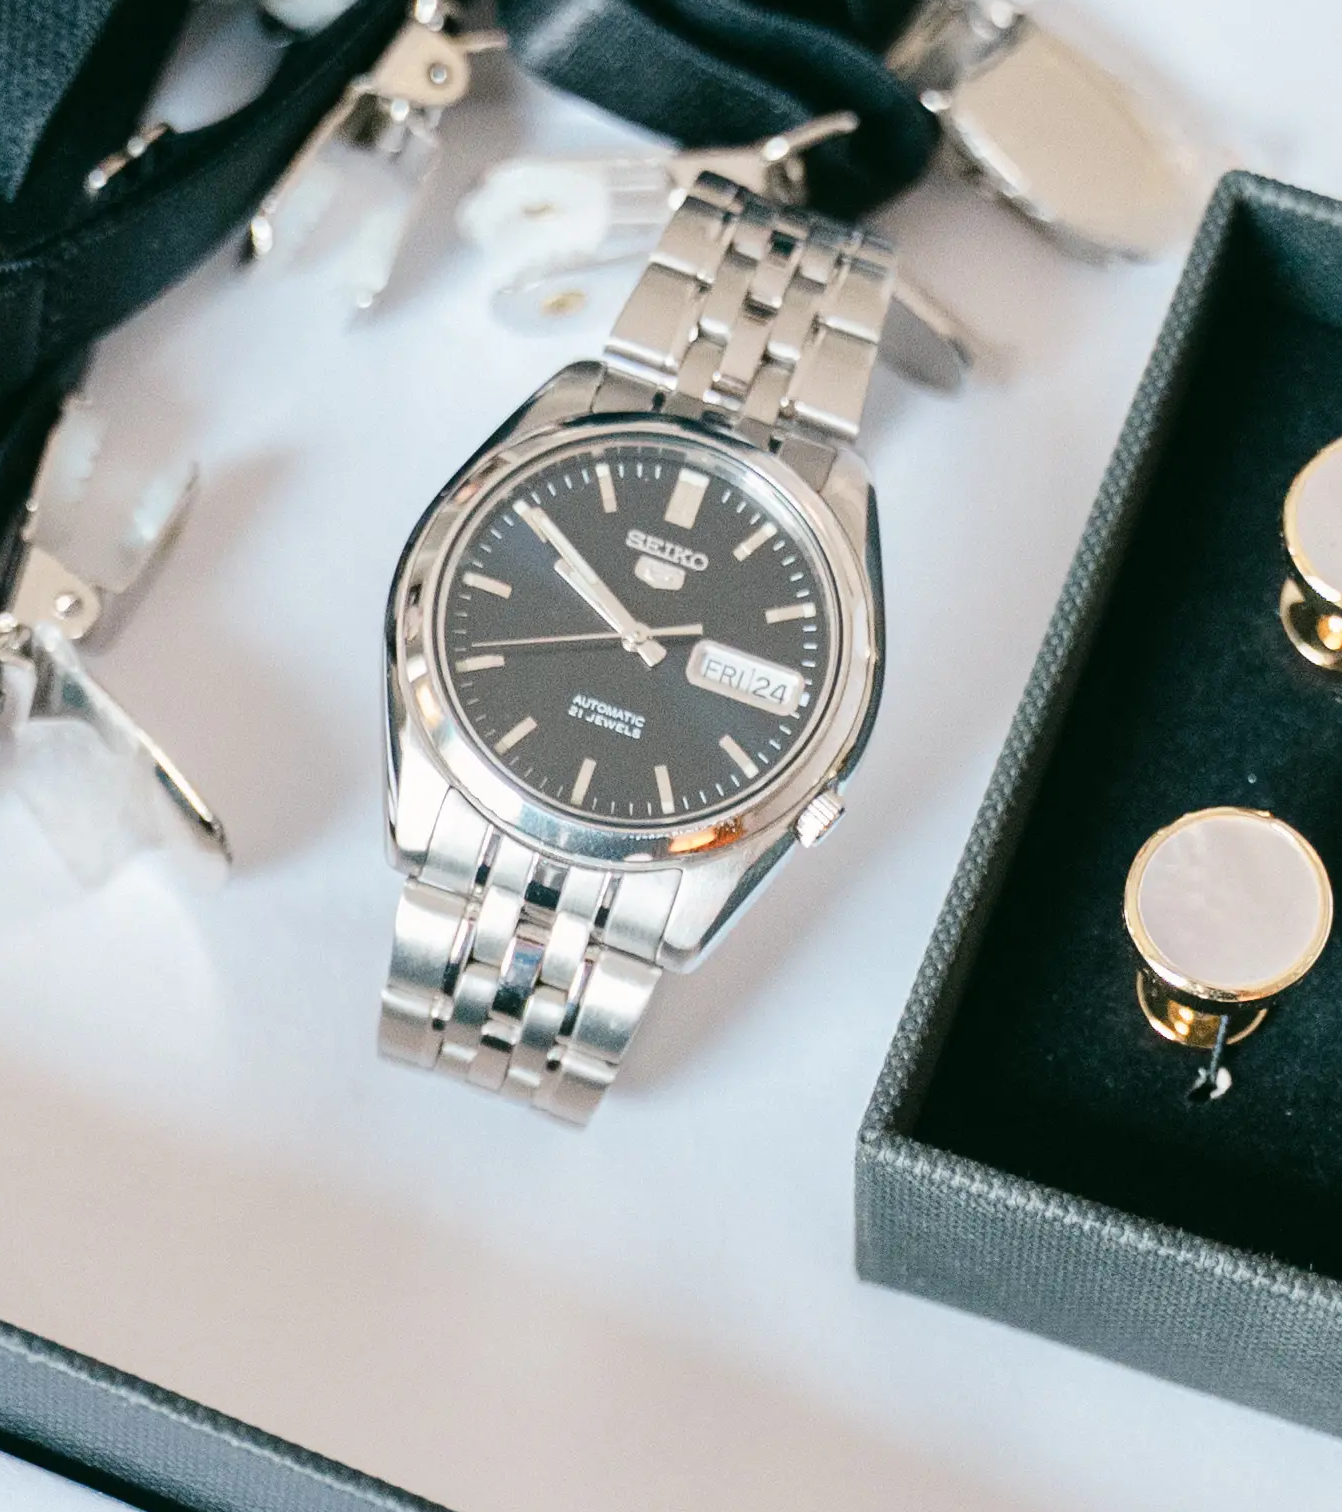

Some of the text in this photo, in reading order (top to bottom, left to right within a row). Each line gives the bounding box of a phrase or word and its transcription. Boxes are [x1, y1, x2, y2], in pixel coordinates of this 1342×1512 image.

[625, 529, 709, 572] SEIKO
[702, 658, 788, 705] FRI 24
[572, 694, 646, 728] AUTOMATIC
[585, 713, 642, 740] JEWELS
